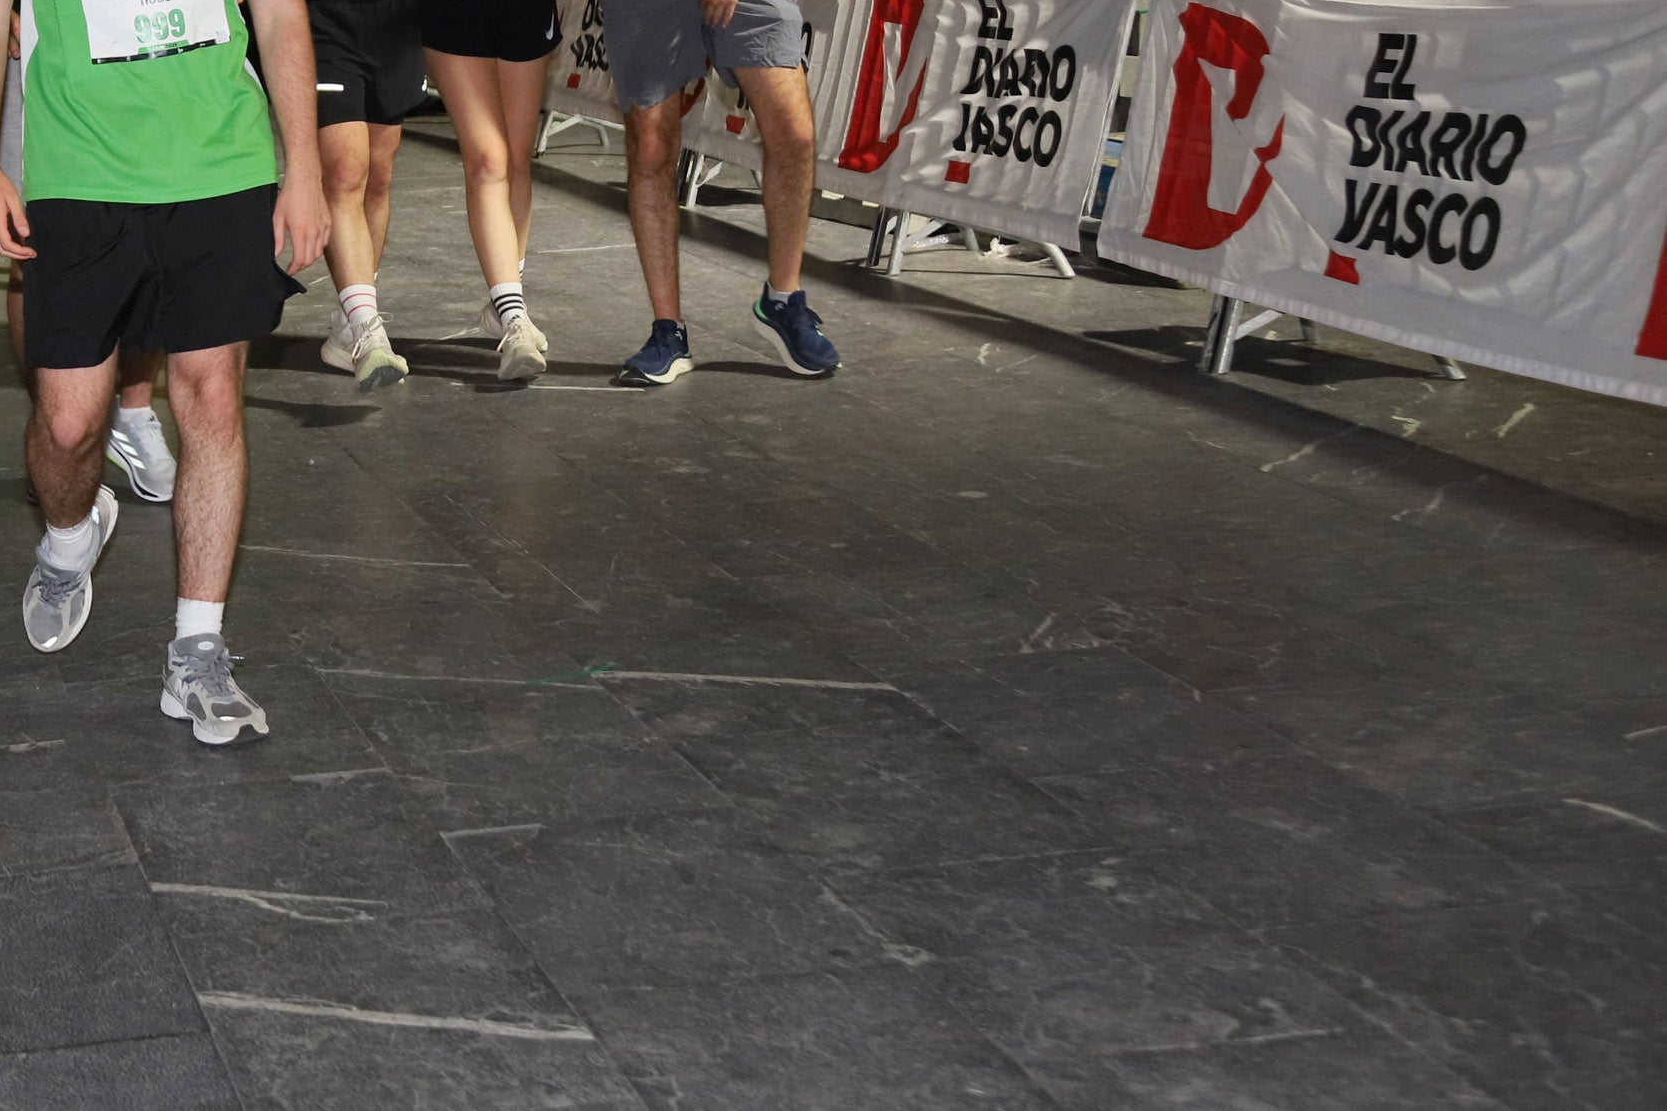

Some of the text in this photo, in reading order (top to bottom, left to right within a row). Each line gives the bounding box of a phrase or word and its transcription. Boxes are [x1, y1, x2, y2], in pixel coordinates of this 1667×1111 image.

[135, 8, 186, 43] 999
[1364, 33, 1417, 100] EL
[1345, 105, 1526, 185] DIARIO
[1334, 180, 1501, 270] VASCO
